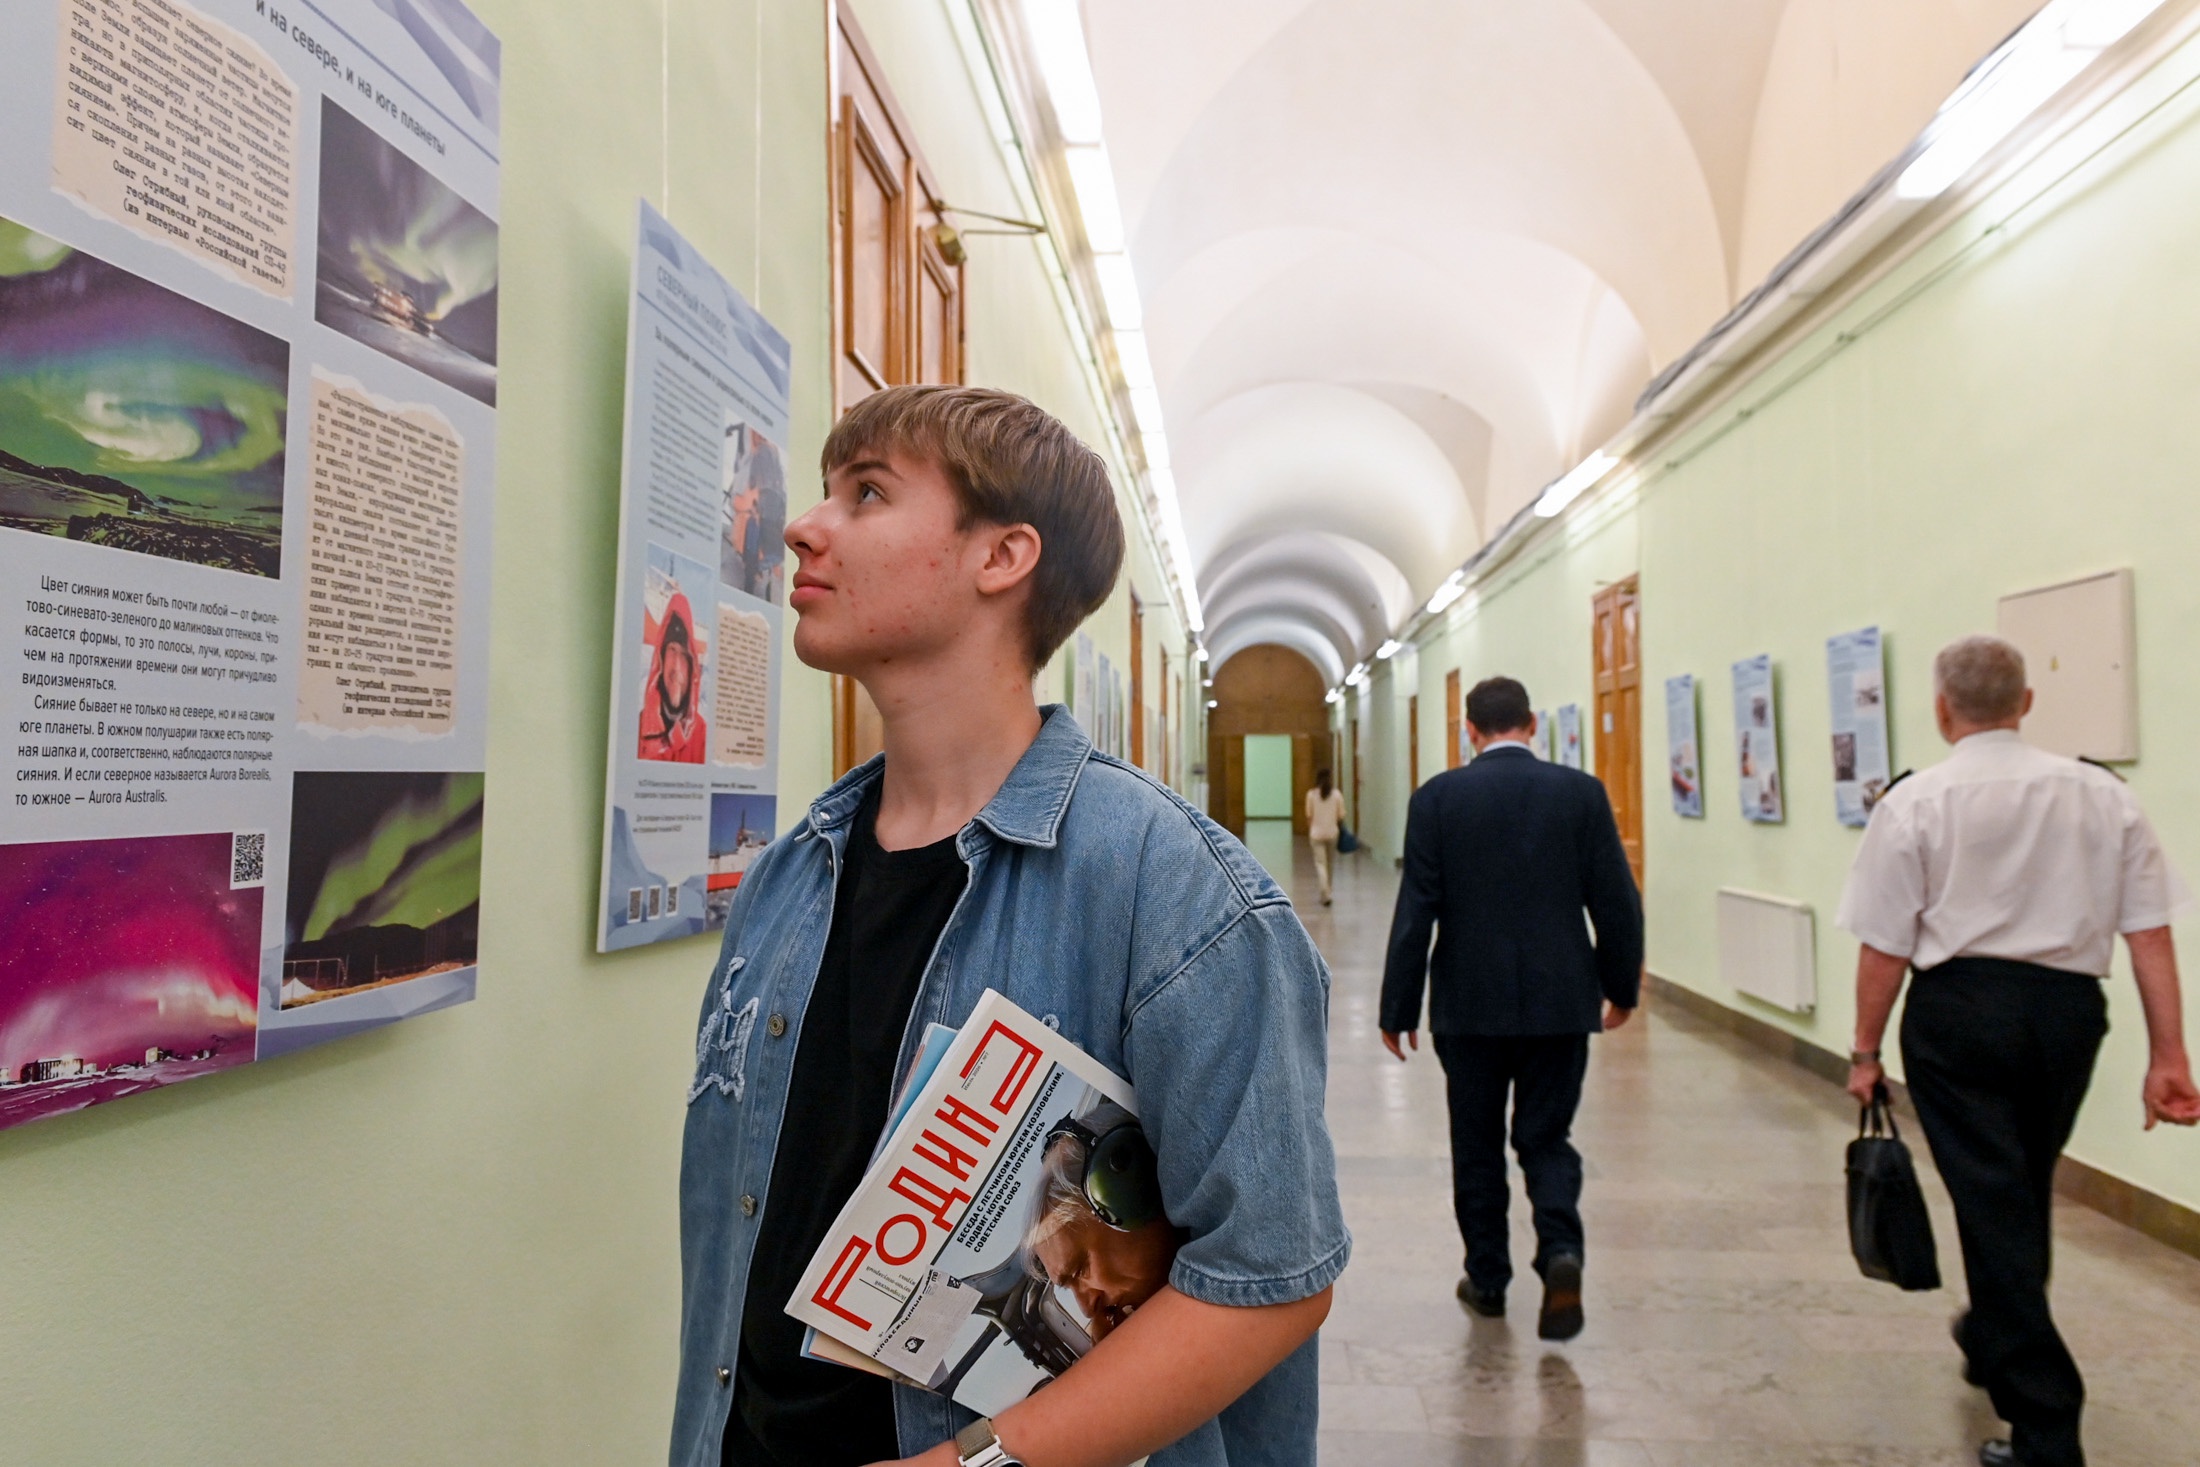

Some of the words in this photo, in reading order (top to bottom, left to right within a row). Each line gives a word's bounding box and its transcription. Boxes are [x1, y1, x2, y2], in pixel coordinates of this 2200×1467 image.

[270, 8, 286, 33] на
[292, 26, 342, 78] севере,
[346, 66, 354, 84] и
[358, 76, 372, 99] на
[376, 90, 398, 119] юге
[401, 112, 446, 156] планеты
[40, 574, 68, 592] Цвет
[70, 582, 109, 598] сияния
[111, 589, 143, 603] может
[145, 592, 169, 608] быть
[171, 598, 197, 612] почти
[198, 602, 228, 616] любой
[239, 609, 249, 620] от
[26, 599, 157, 628] тово-синевато-зеленого
[158, 618, 171, 630] до
[172, 620, 223, 636] малиновых
[24, 624, 75, 640] касается
[79, 628, 120, 647] формы,
[124, 635, 135, 647] то
[138, 637, 154, 650] это
[157, 639, 195, 654] полосы,
[197, 644, 221, 658] лучи,
[224, 648, 257, 662] короны,
[21, 672, 116, 690] видоизменяться.
[23, 648, 46, 661] чем
[50, 651, 64, 663] на
[68, 652, 132, 669] протяжении
[135, 659, 178, 673] времени
[180, 664, 198, 675] они
[200, 666, 226, 680] могут
[33, 694, 76, 711] Сияние
[78, 697, 117, 713] бывает
[119, 703, 132, 714] не
[134, 703, 167, 716] только
[168, 706, 180, 717] на
[182, 706, 216, 720] севере,
[217, 708, 229, 719] но
[230, 710, 236, 719] и
[237, 710, 248, 720] на
[249, 710, 275, 721] самом
[18, 721, 42, 733] юге
[44, 722, 94, 735] планеты.
[97, 720, 104, 735] В
[106, 724, 142, 736] южном
[144, 726, 197, 740] полушарии
[199, 728, 225, 739] также
[226, 729, 245, 740] есть
[17, 745, 38, 757] ная
[41, 745, 77, 757] шапка
[79, 746, 88, 759] и,
[90, 746, 170, 759] соответственно,
[172, 746, 231, 760] наблюдаются
[16, 769, 60, 781] сияния.
[64, 766, 72, 780] И
[74, 769, 101, 781] если
[103, 769, 151, 783] северное
[153, 770, 207, 780] называется
[208, 767, 237, 780] Aurora
[15, 793, 28, 805] то
[31, 793, 71, 805] южное
[88, 790, 122, 804] Aurora
[124, 789, 167, 803] Australis.
[956, 1212, 980, 1243] БЕСЕДА
[976, 1204, 984, 1212] С
[980, 1159, 1011, 1206] ЛЕТЧИКОМ
[1007, 1128, 1030, 1160] ЮРИЕМ
[1026, 1071, 1064, 1129] КОЗЛОВСКИМ,
[964, 1214, 988, 1248] ПОДВИГ
[985, 1173, 1014, 1215] КОТОРОГО
[1010, 1141, 1033, 1174] ПОТРЯС
[1029, 1121, 1045, 1142] ВЕСЬ
[973, 1204, 1006, 1253] СОВЕТСКИЙ
[1002, 1180, 1021, 1205] СОЮЗ
